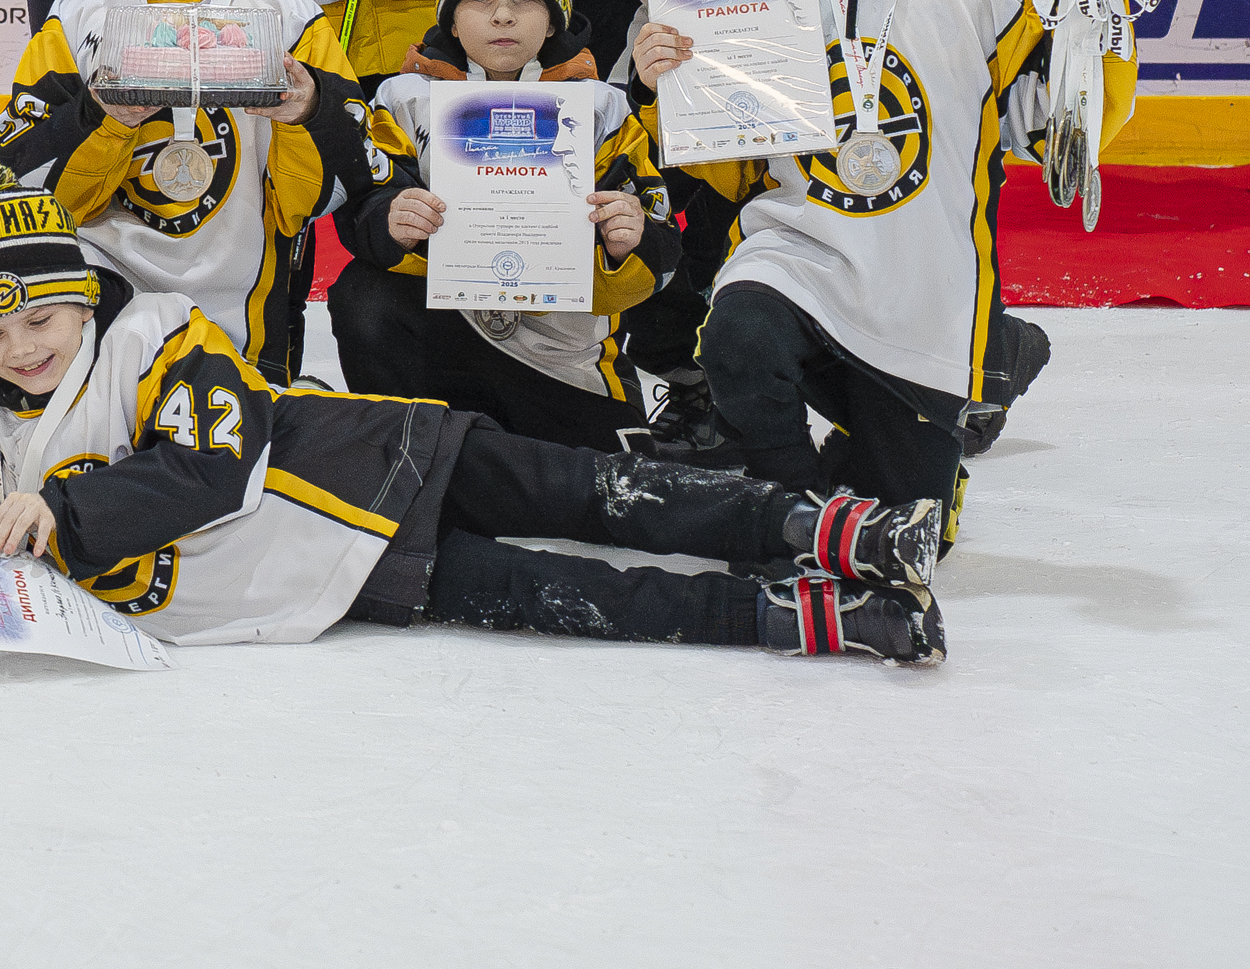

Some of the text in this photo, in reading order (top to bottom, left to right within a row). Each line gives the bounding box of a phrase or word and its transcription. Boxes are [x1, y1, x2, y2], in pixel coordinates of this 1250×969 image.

[697, 1, 770, 19] ГРАМОТА
[495, 118, 531, 127] ТУРНИР
[477, 166, 548, 176] ГРАМОТА
[810, 169, 924, 210] ЕРГИЯ
[155, 380, 244, 460] 42
[13, 570, 38, 623] ДИПЛОМ
[127, 553, 173, 613] ЕРГИ
